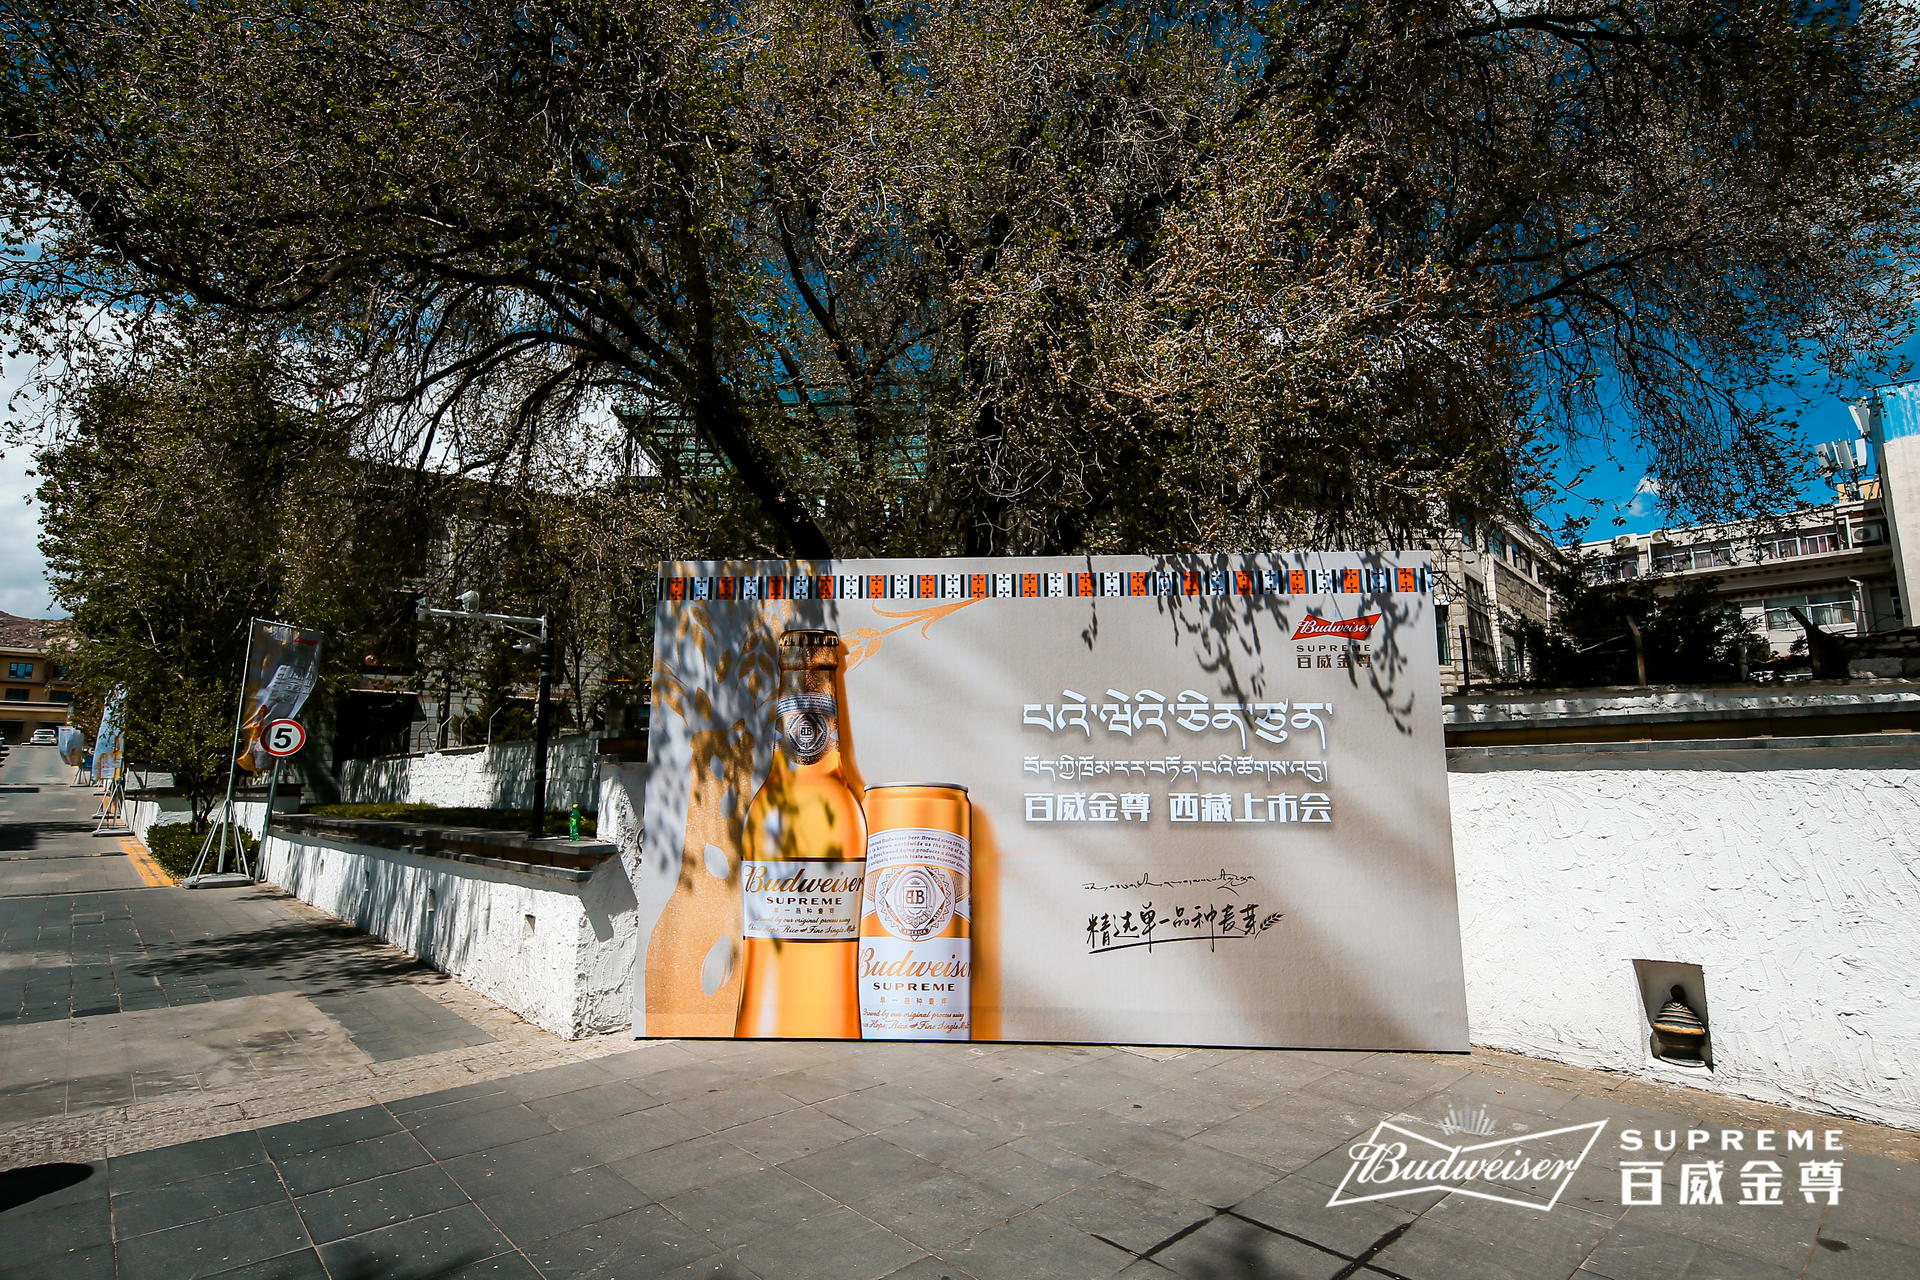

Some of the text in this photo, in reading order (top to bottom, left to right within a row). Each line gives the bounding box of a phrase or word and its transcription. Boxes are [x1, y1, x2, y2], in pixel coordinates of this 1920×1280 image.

[1296, 620, 1376, 634] Budweiser
[1296, 644, 1371, 652] SUPREME
[1296, 653, 1371, 669] 百威金尊
[273, 728, 292, 749] 5
[1023, 792, 1333, 823] 百威金尊 西藏上市会
[743, 865, 864, 893] Budweiser
[766, 897, 842, 905] SUPREME
[1086, 901, 1260, 953] 精选单一品种麦芽
[873, 982, 955, 991] SUPREME
